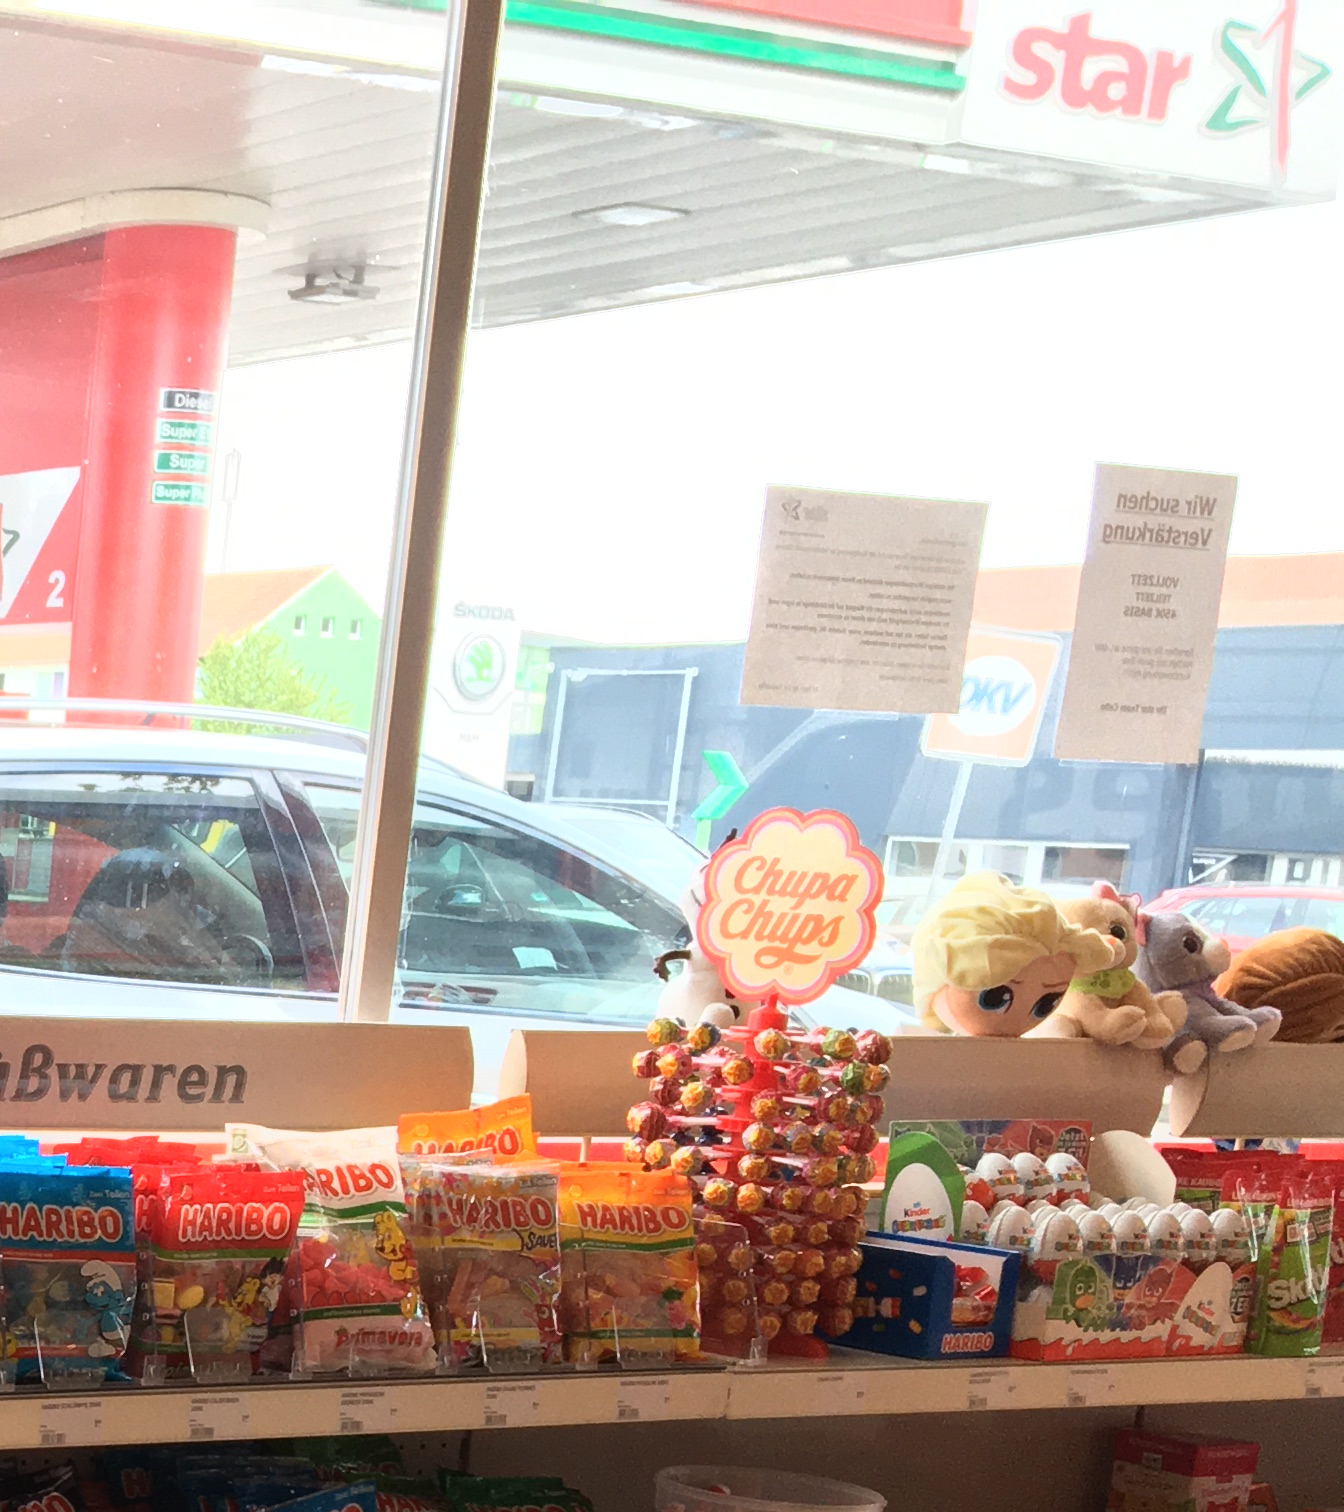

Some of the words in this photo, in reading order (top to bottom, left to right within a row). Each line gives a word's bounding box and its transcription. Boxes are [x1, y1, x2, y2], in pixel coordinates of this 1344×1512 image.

[1003, 12, 1192, 121] star
[161, 422, 197, 441] Super
[169, 453, 205, 472] Super
[155, 484, 191, 500] Super
[46, 571, 65, 608] 2
[733, 854, 857, 903] Chupa
[719, 898, 844, 968] Chups
[179, 1203, 292, 1241] HARIBO
[446, 1195, 556, 1232] HARIBO
[578, 1200, 691, 1236] HARIBO
[941, 1331, 994, 1354] HARIBO
